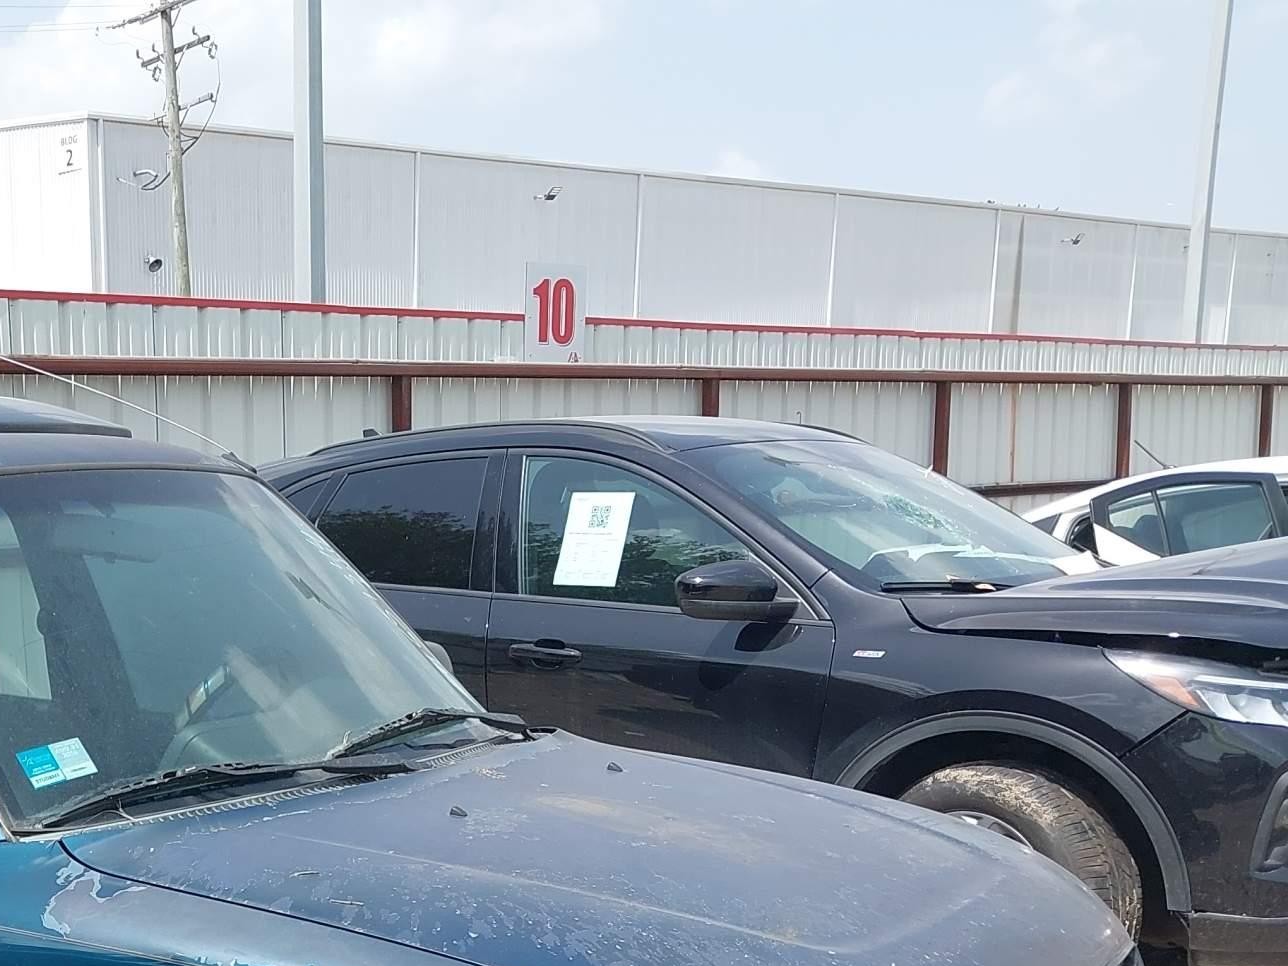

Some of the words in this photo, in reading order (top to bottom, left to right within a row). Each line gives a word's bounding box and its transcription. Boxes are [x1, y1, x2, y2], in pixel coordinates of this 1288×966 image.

[60, 134, 78, 146] BLDG
[65, 149, 74, 167] 2
[532, 277, 576, 346] 10
